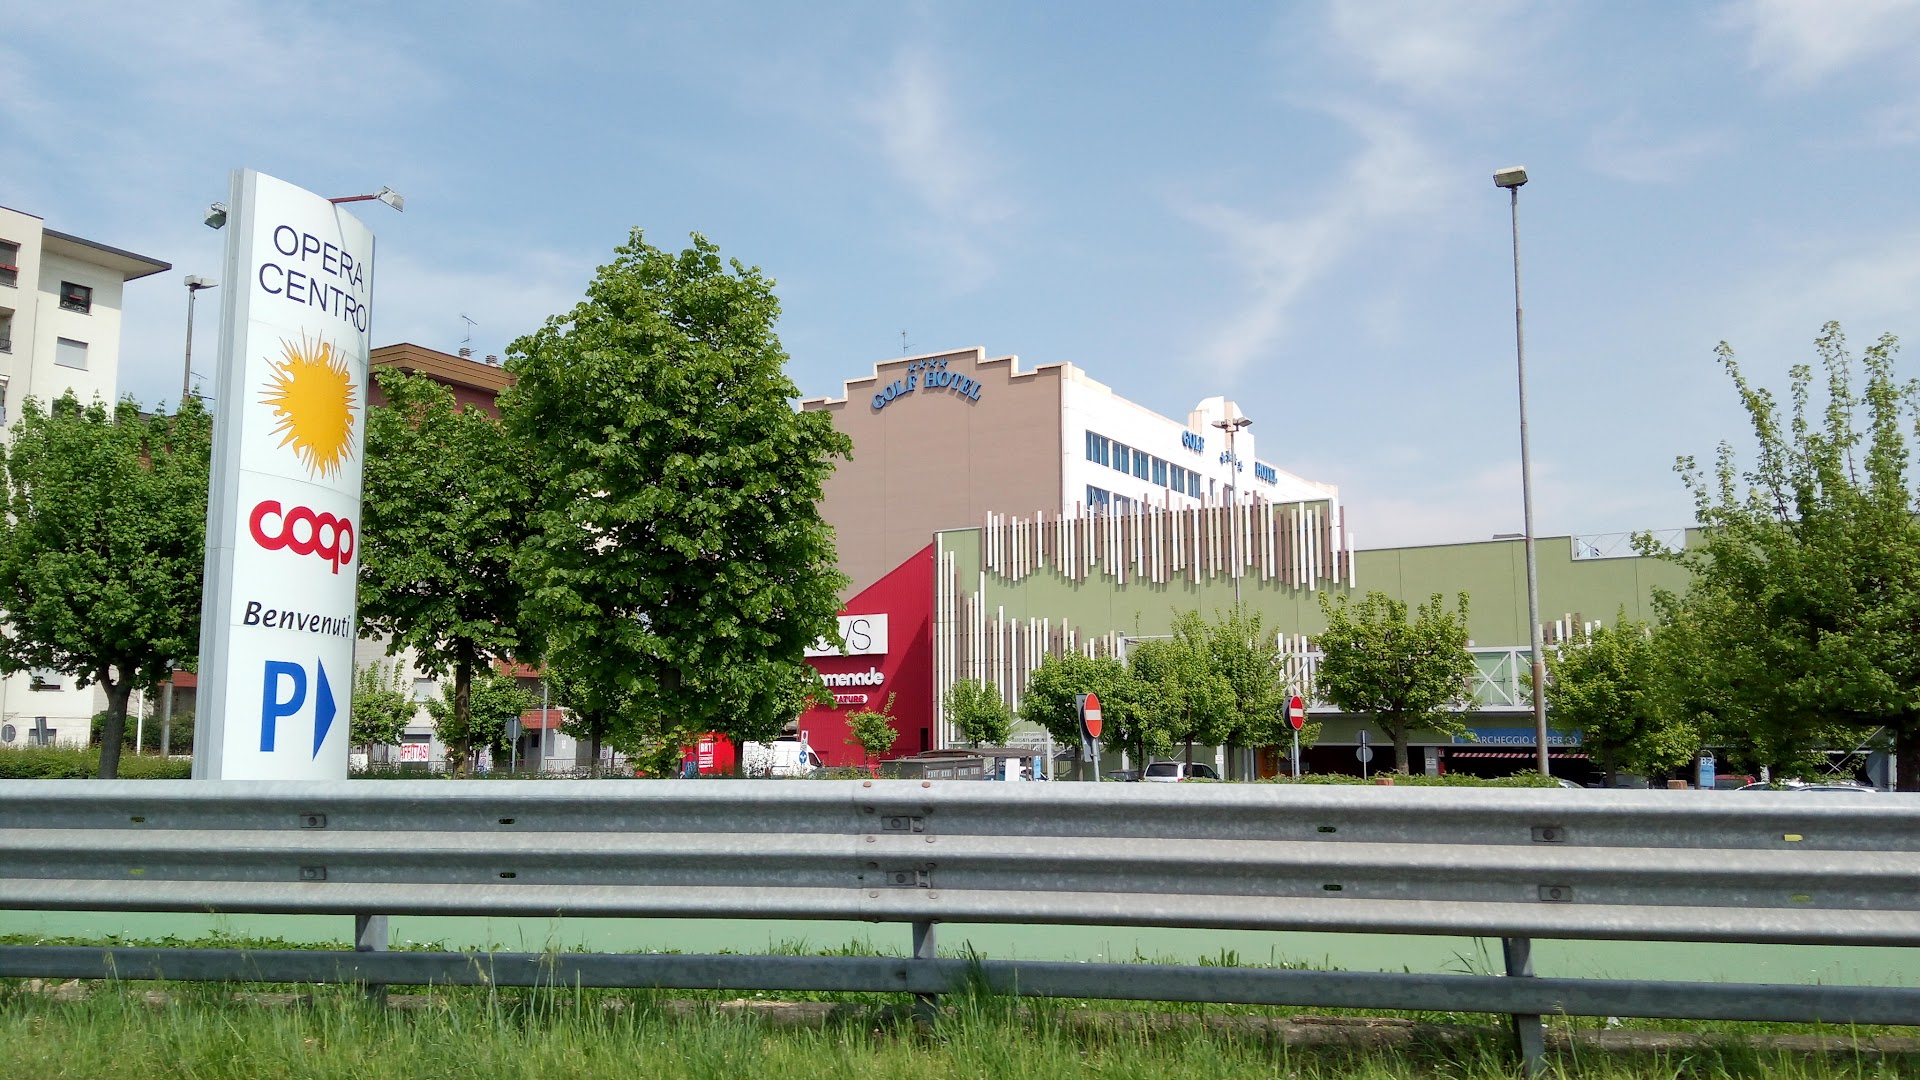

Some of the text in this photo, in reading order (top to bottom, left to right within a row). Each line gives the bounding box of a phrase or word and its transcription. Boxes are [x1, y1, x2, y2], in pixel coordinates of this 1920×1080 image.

[273, 224, 364, 293] OPERA
[258, 262, 367, 333] CENTRO
[871, 370, 982, 410] GOLF HOTEL
[1181, 430, 1205, 452] GOLF
[242, 600, 351, 639] Benvenuti
[819, 667, 885, 687] menade
[259, 660, 307, 753] P
[1475, 735, 1529, 744] ARCHEGGIO
